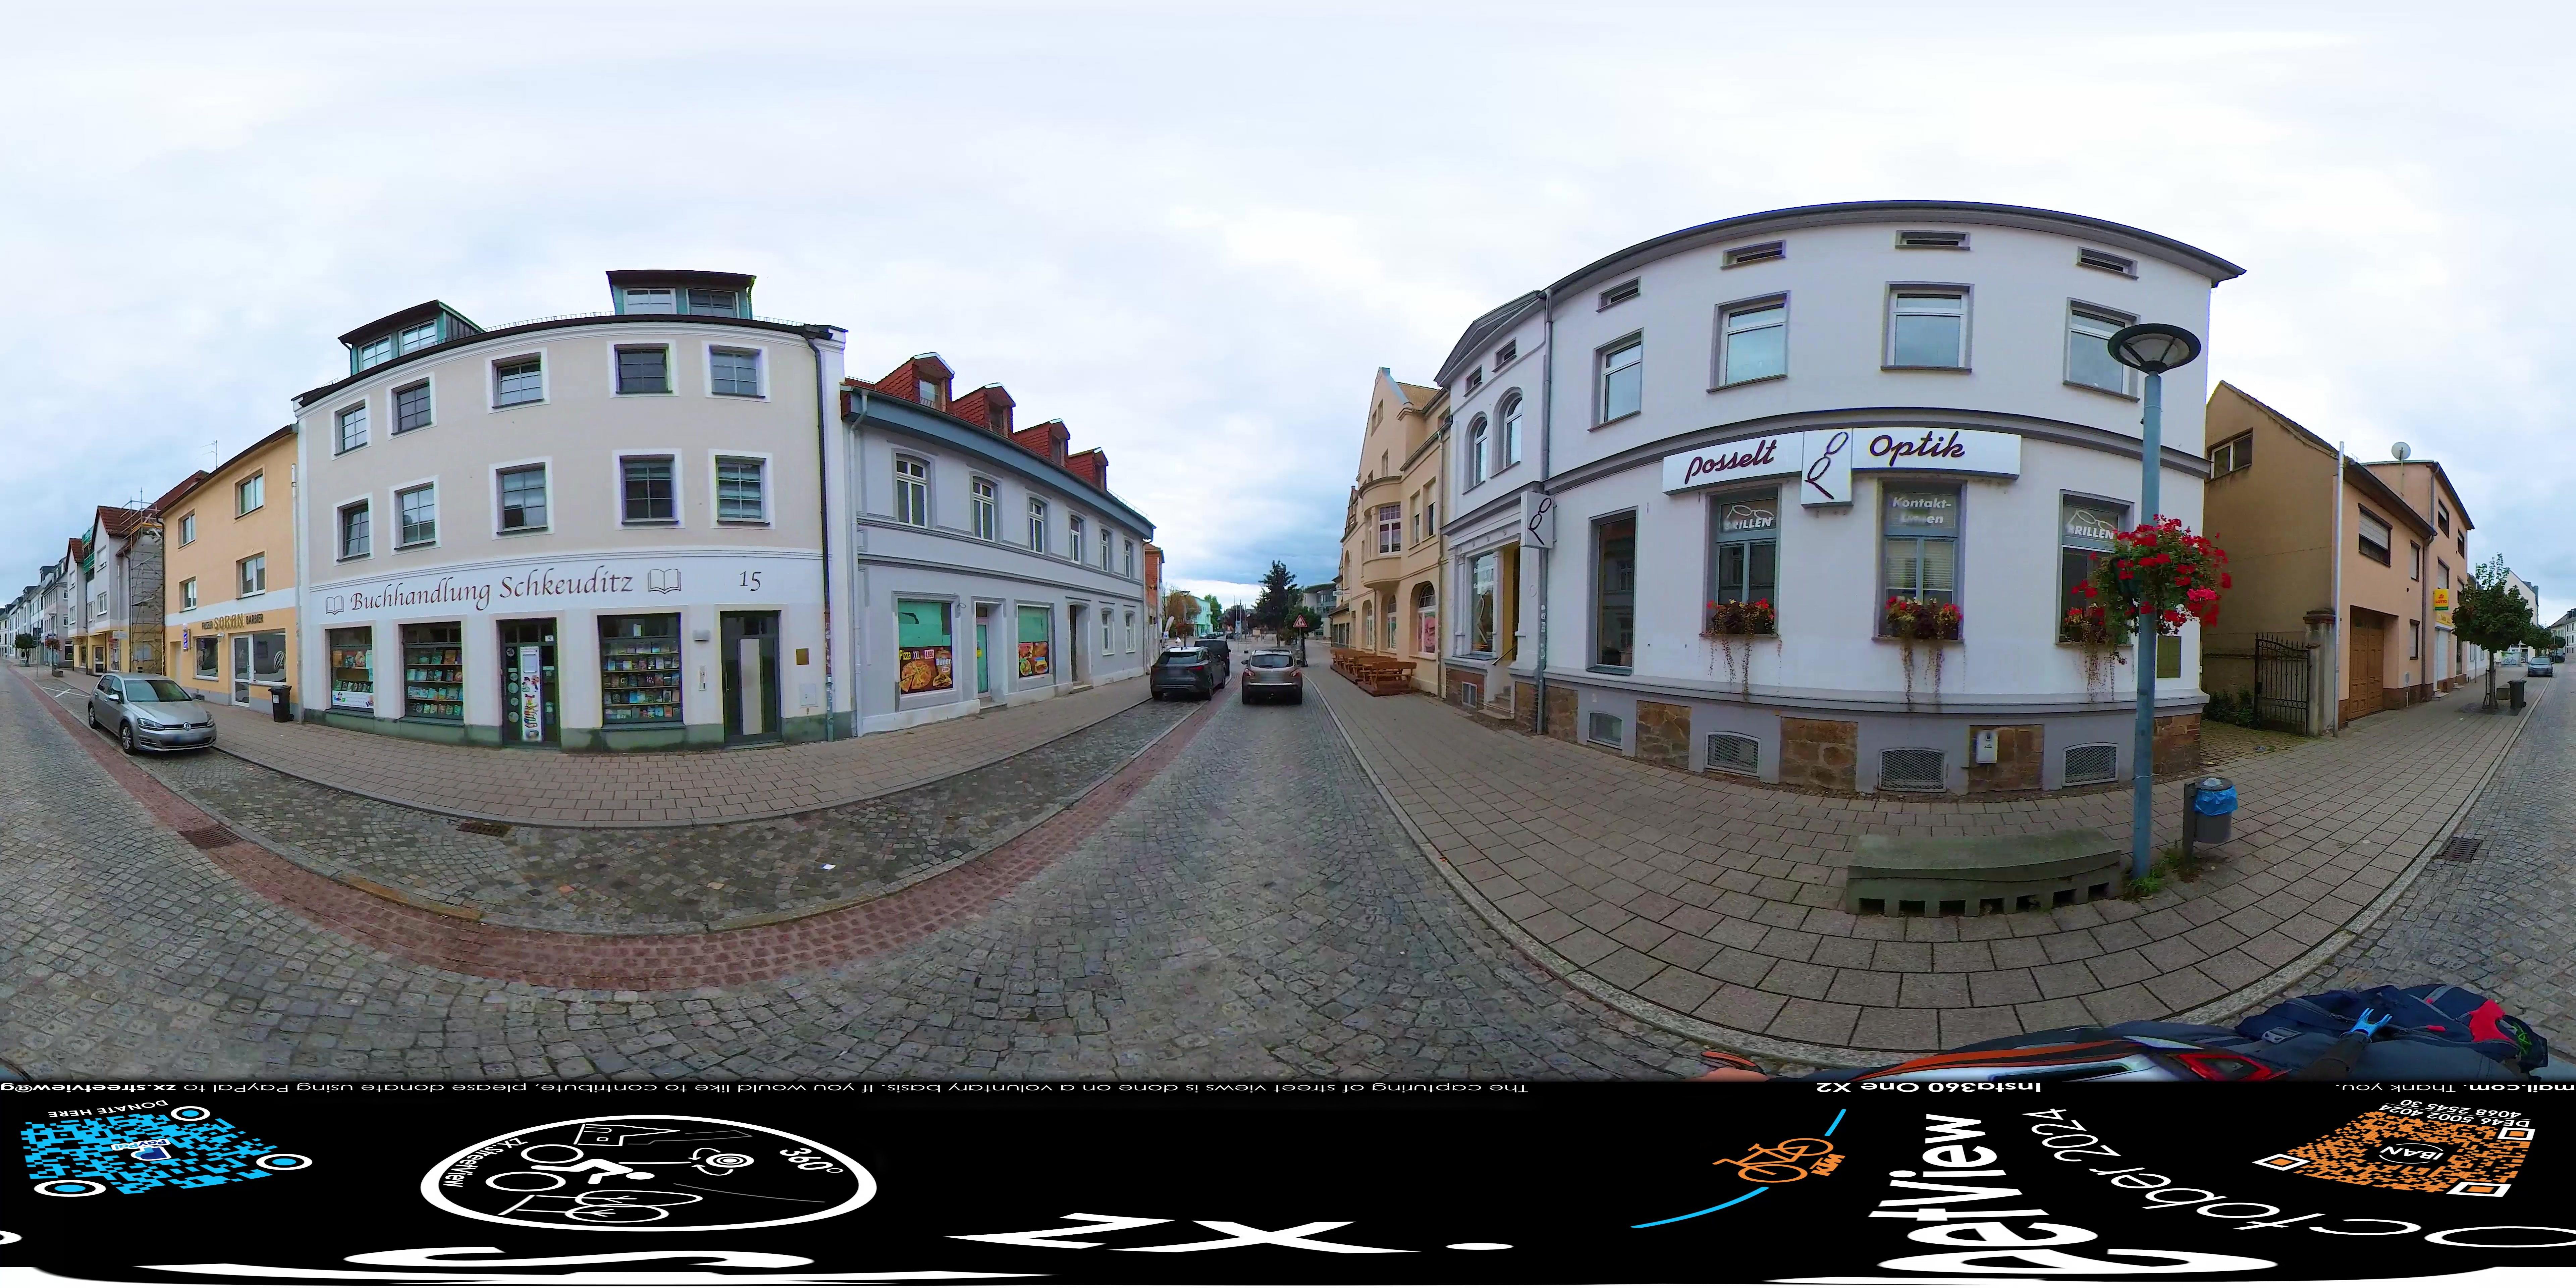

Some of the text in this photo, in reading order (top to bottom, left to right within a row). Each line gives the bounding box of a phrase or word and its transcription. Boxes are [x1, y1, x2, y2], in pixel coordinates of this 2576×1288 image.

[1870, 431, 1965, 467] Optik
[1892, 497, 1951, 508] Kontakt-
[350, 566, 634, 610] Buchhandlung Schkeuditz
[739, 571, 761, 591] 15
[246, 613, 263, 625] BARBIER
[899, 650, 911, 660] Pizza
